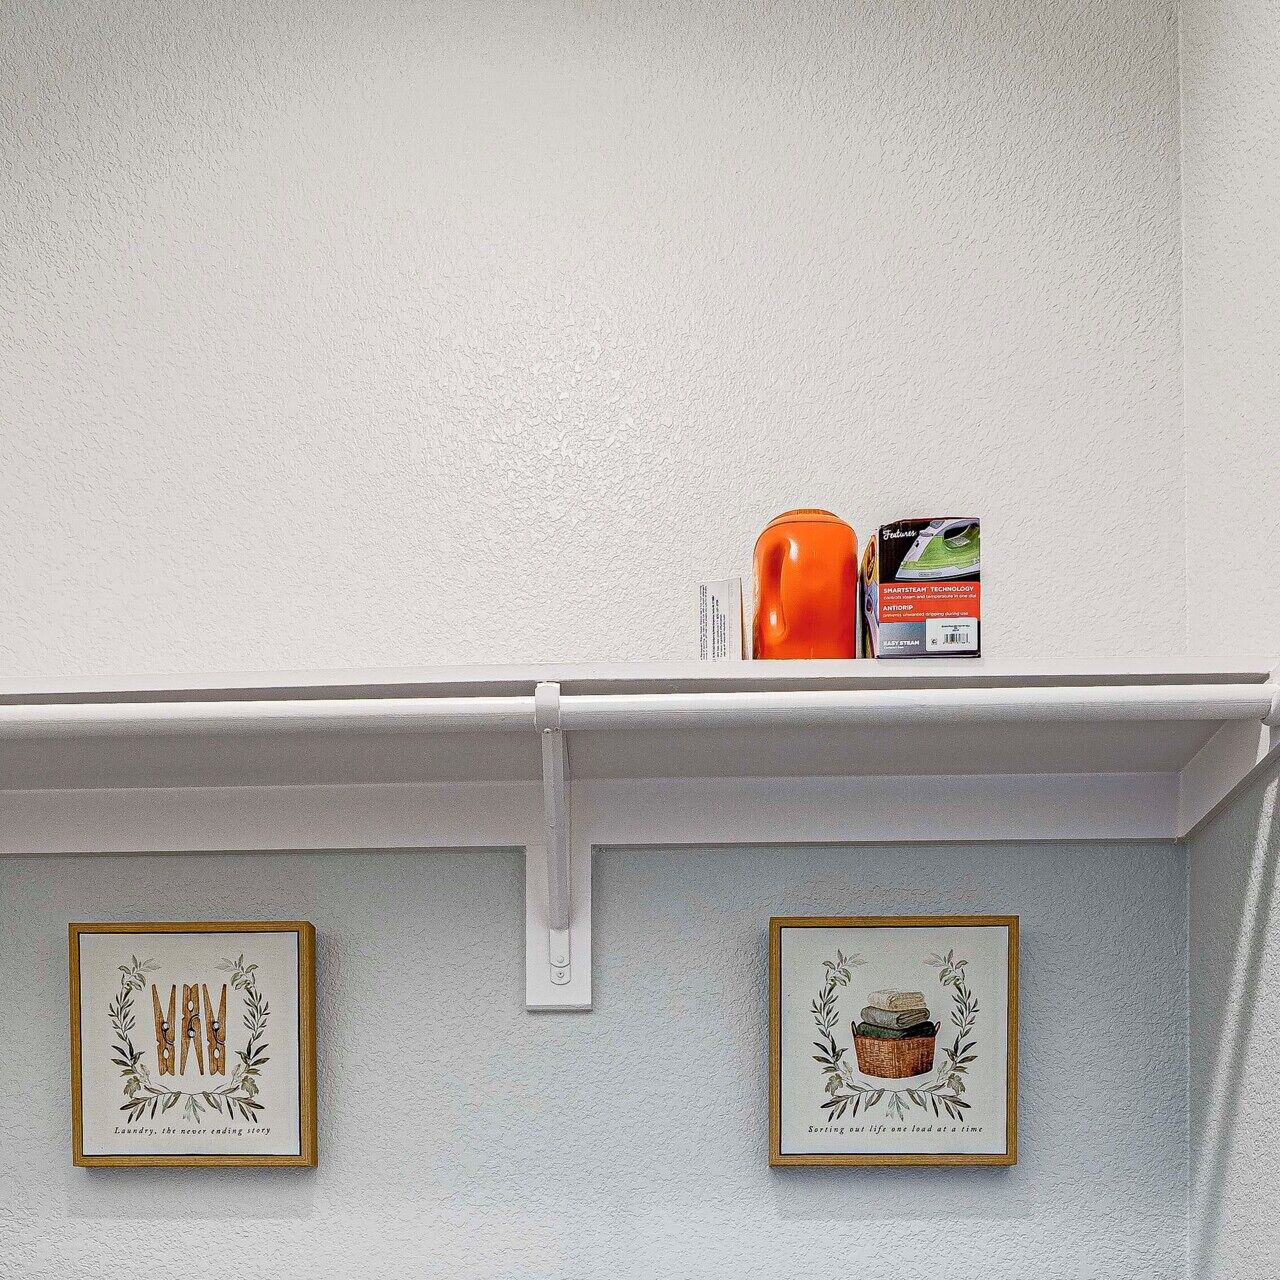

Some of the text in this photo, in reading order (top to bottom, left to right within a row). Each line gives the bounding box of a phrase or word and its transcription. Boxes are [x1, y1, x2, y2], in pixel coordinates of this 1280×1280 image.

[114, 1127, 156, 1136] Laundry,
[211, 1127, 243, 1136] ending
[247, 1127, 270, 1135] story
[808, 1125, 844, 1134] Sorting
[870, 1125, 886, 1134] life
[961, 1125, 983, 1133] time
